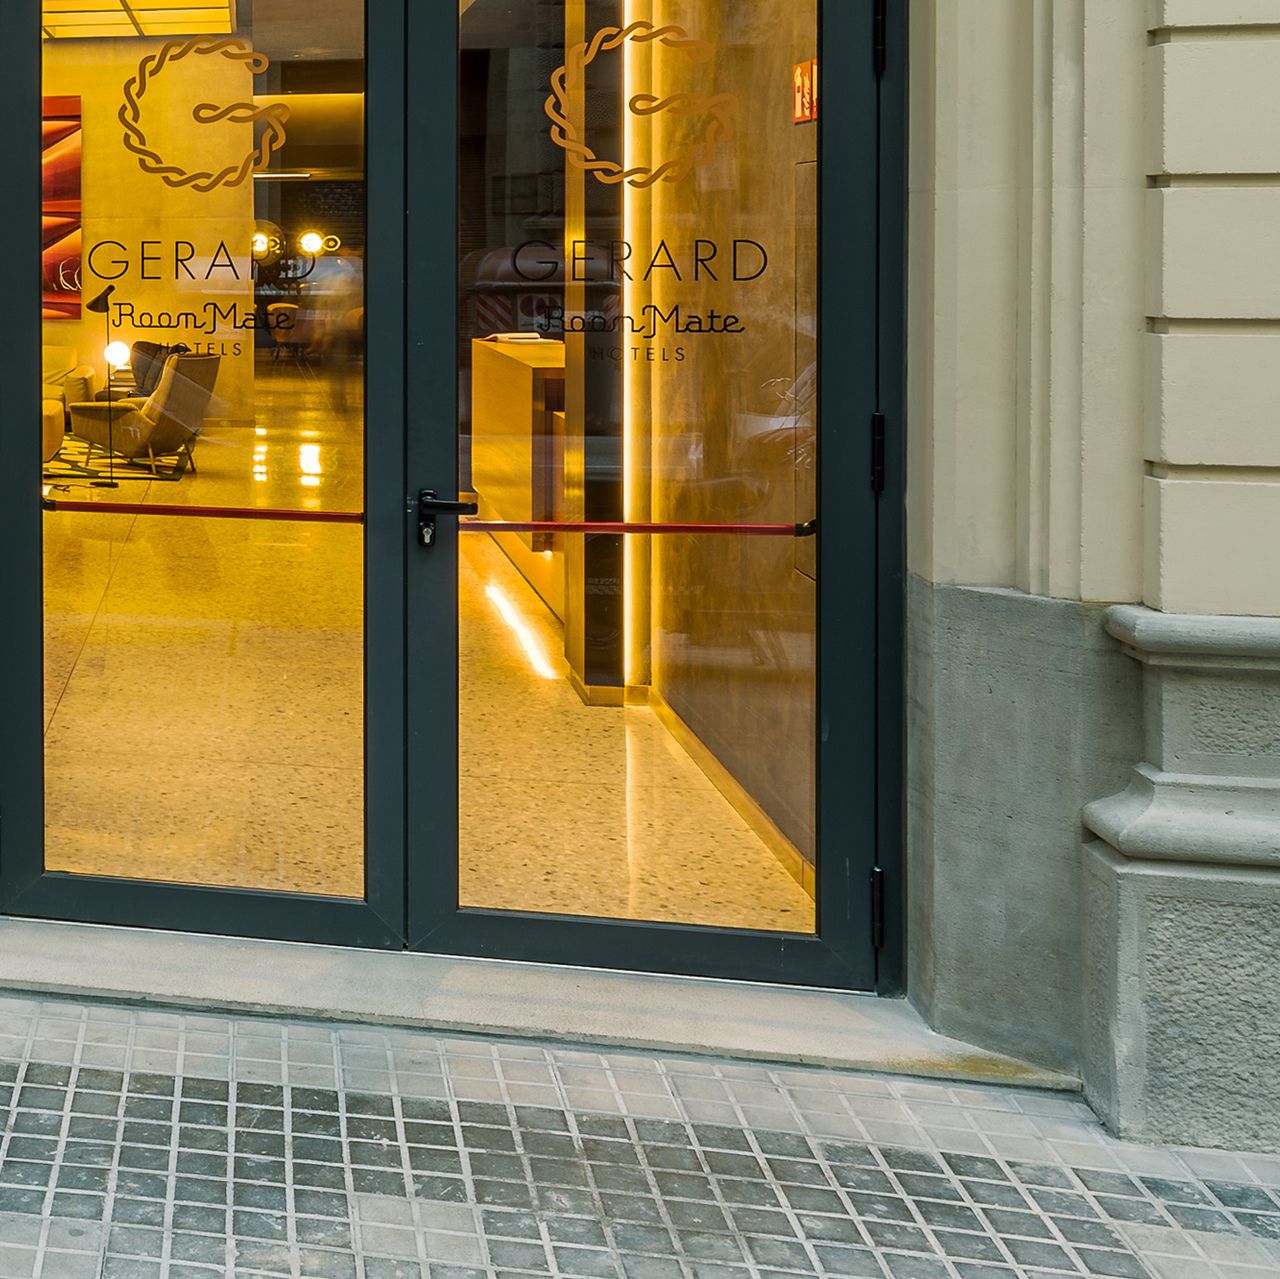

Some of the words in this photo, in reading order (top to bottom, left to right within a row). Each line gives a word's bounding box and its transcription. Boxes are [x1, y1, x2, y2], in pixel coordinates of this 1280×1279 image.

[511, 239, 769, 282] GERARD
[158, 341, 243, 357] HOTELS
[592, 346, 686, 362] HOTELS
